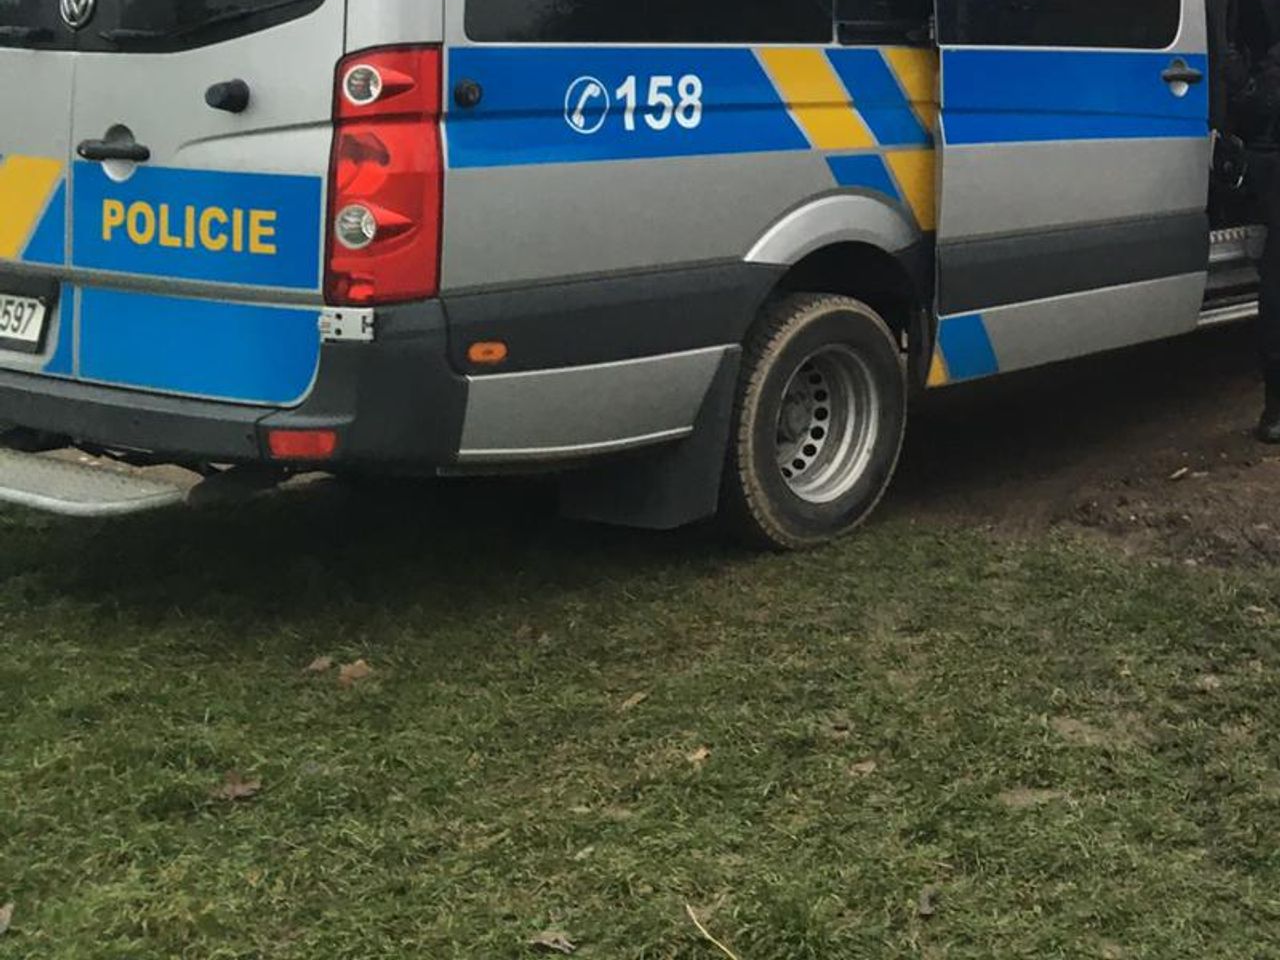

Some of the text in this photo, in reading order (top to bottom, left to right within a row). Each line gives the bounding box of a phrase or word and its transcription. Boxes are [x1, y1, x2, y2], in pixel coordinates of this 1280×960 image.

[615, 74, 703, 131] 158
[102, 198, 277, 255] POLICIE
[0, 299, 38, 334] 597
